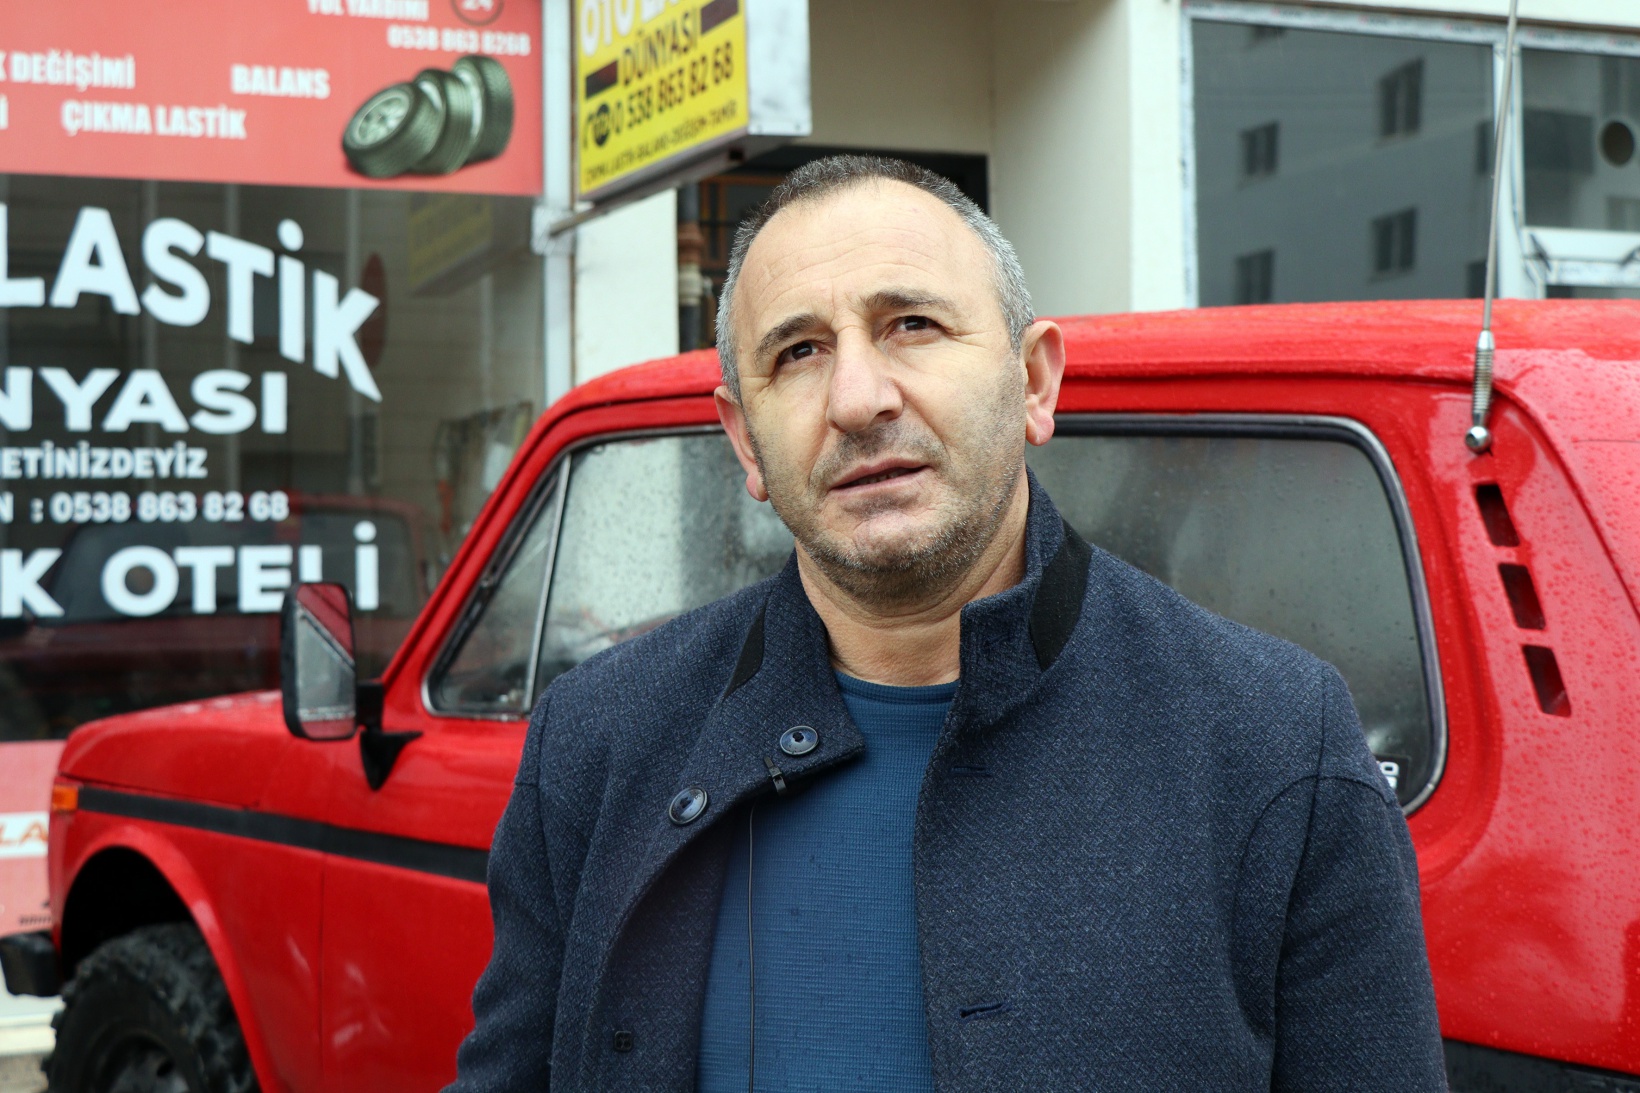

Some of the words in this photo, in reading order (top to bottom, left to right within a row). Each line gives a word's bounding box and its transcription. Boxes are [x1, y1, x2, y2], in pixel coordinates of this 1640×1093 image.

[11, 48, 135, 92] DEĞİŞİMİ
[230, 63, 331, 99] BALANS
[61, 99, 153, 137] ÇIKMA
[155, 102, 247, 139] LASTİK
[0, 204, 382, 402] LASTİK
[50, 491, 131, 523] 0538
[138, 491, 196, 523] 863
[203, 491, 245, 522] 82
[249, 490, 290, 522] 68
